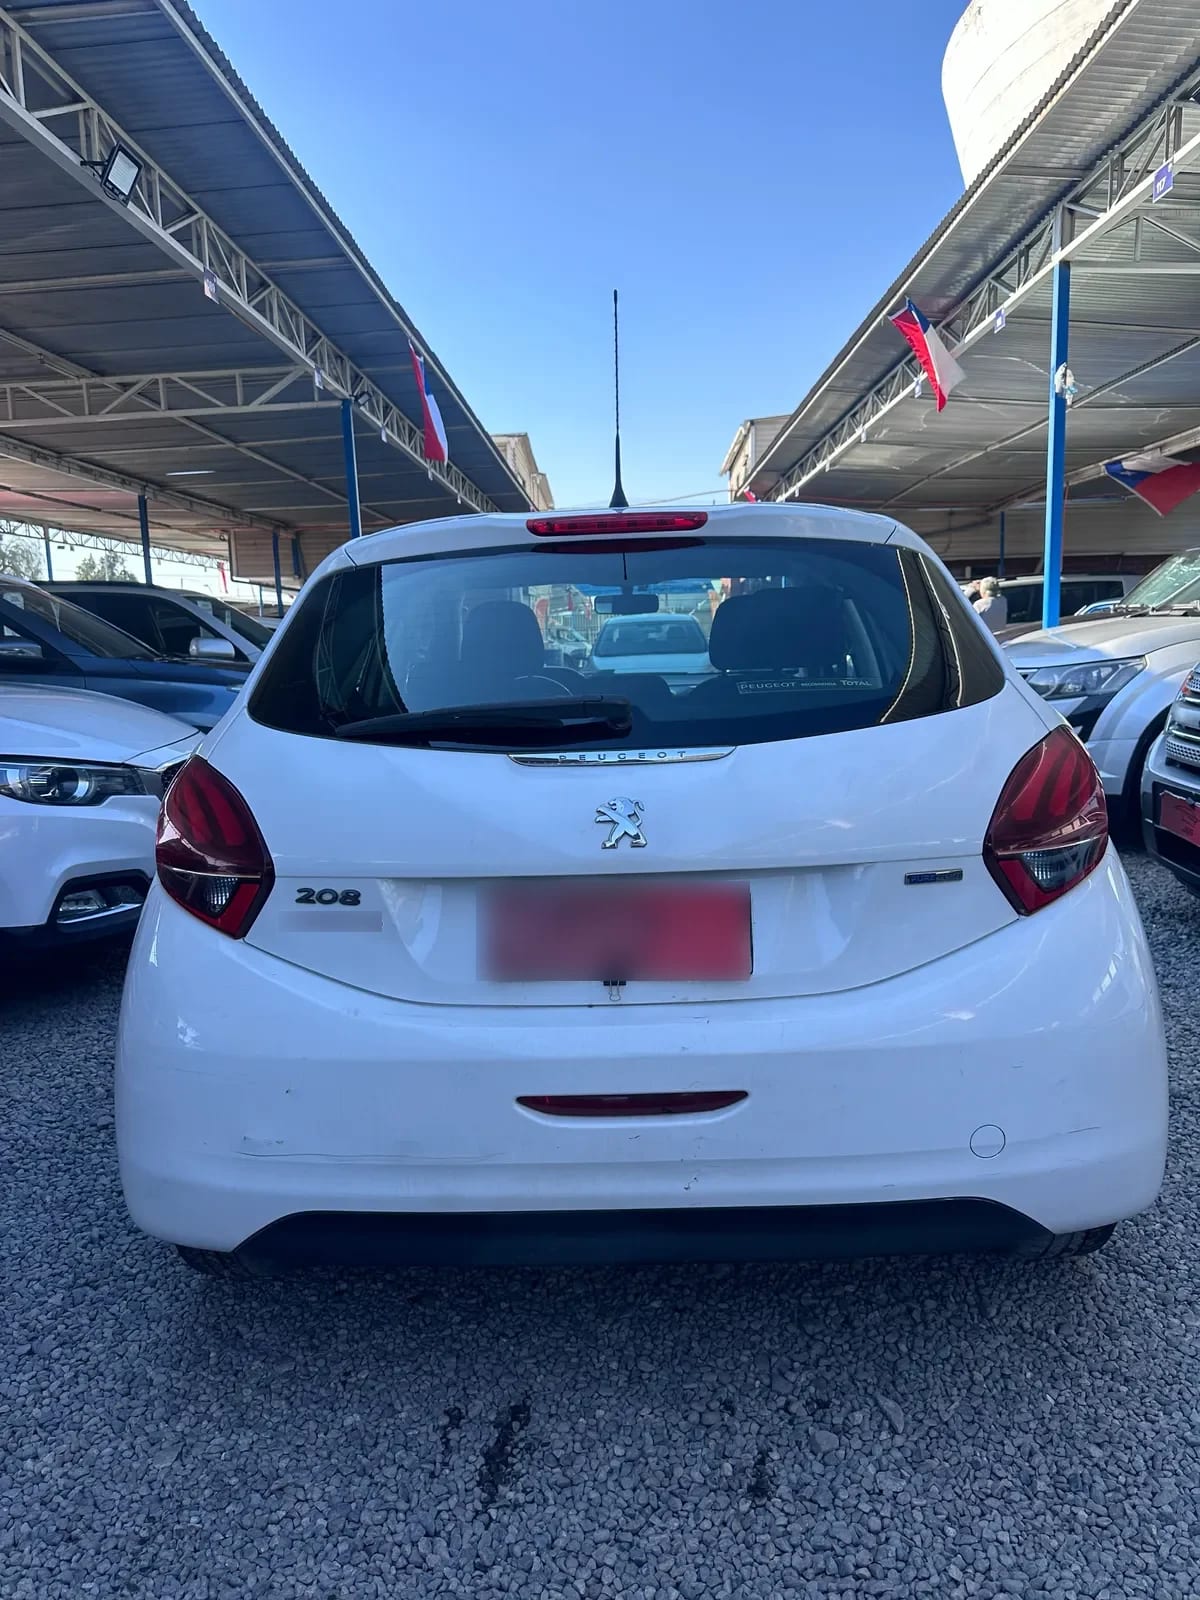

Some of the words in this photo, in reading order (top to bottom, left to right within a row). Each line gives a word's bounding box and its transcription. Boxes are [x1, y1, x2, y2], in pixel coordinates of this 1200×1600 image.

[740, 681, 797, 690] PEUGEOT
[559, 751, 686, 762] PEUGEOT
[295, 887, 362, 906] 208
